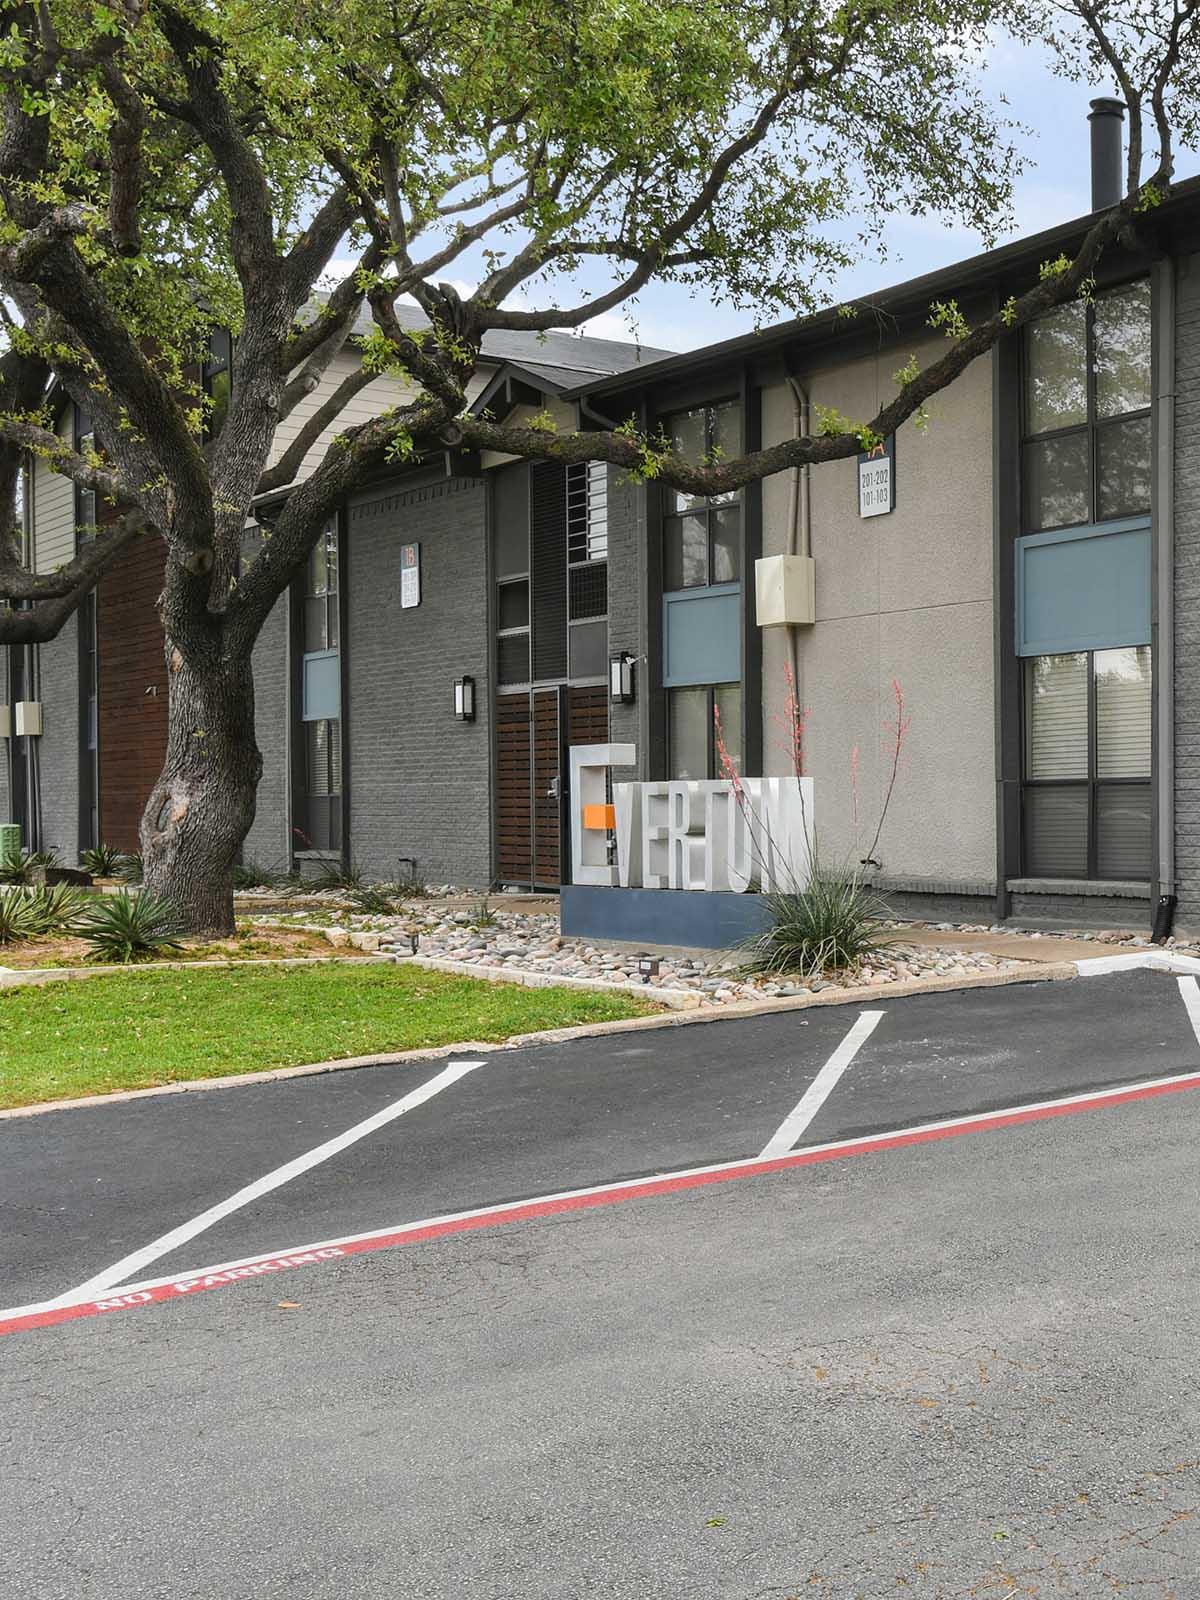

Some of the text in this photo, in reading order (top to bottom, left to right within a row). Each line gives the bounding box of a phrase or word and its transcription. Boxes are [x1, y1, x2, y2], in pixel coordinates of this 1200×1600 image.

[862, 468, 888, 489] 201-202
[862, 488, 888, 507] 101-103
[569, 743, 814, 895] EVERTON
[95, 1247, 346, 1311] NO PARKING
